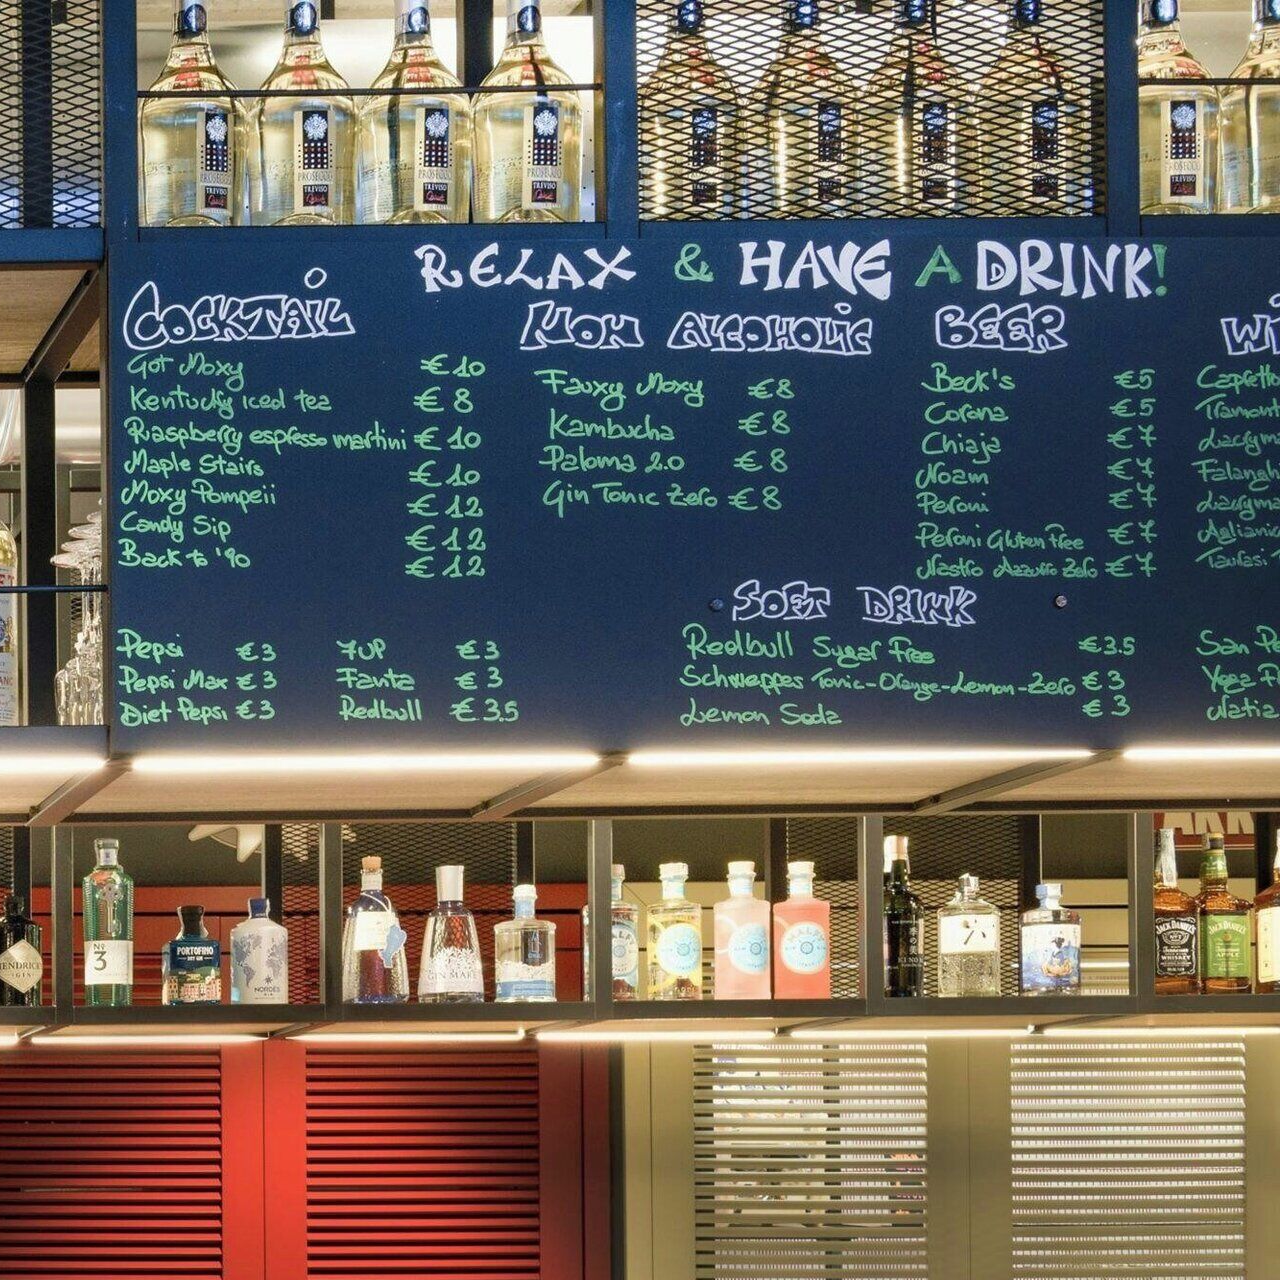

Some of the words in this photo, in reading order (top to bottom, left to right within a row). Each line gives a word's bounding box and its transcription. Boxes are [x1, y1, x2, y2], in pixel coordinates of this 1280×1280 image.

[413, 241, 638, 294] RELAX
[673, 242, 715, 283] &
[738, 238, 893, 302] HAVE
[914, 244, 963, 288] A
[934, 302, 1069, 355] BEER
[178, 351, 245, 393] Moxy
[242, 387, 287, 411] iced
[292, 388, 333, 413] tea
[635, 371, 706, 408] Moxy
[923, 401, 1010, 425] Corona
[123, 415, 244, 457] Raspberry
[248, 425, 329, 456] espresso
[331, 419, 408, 451] martini
[123, 447, 192, 480] Maple
[198, 453, 265, 477] Stairs
[538, 444, 638, 473] Paloma
[914, 461, 990, 490] Noam
[120, 478, 187, 516] Moxy
[190, 477, 276, 515] Pompeii
[541, 479, 590, 519] Gin
[591, 481, 661, 506] Tonic
[915, 490, 990, 516] Peroni
[119, 510, 185, 544] Candy
[192, 514, 232, 544] Sip
[914, 521, 982, 549] Peroni
[986, 528, 1046, 552] Gluten
[117, 537, 184, 569] Back
[115, 627, 185, 665] Pepsi
[335, 637, 387, 661] 7UP
[681, 622, 794, 661] Redbull
[812, 635, 883, 669] Sugar
[887, 635, 936, 665] Free
[1195, 629, 1251, 657] San
[118, 664, 176, 695] Pepsi
[182, 668, 229, 691] Max
[335, 667, 416, 692] Fanta
[118, 699, 173, 727] Diet
[176, 696, 229, 726] Pepsi
[338, 694, 423, 722] Redbull
[679, 697, 770, 727] Lemon
[779, 702, 843, 726] Soda
[94, 950, 106, 970] 3
[176, 946, 214, 956] PORTOFINO
